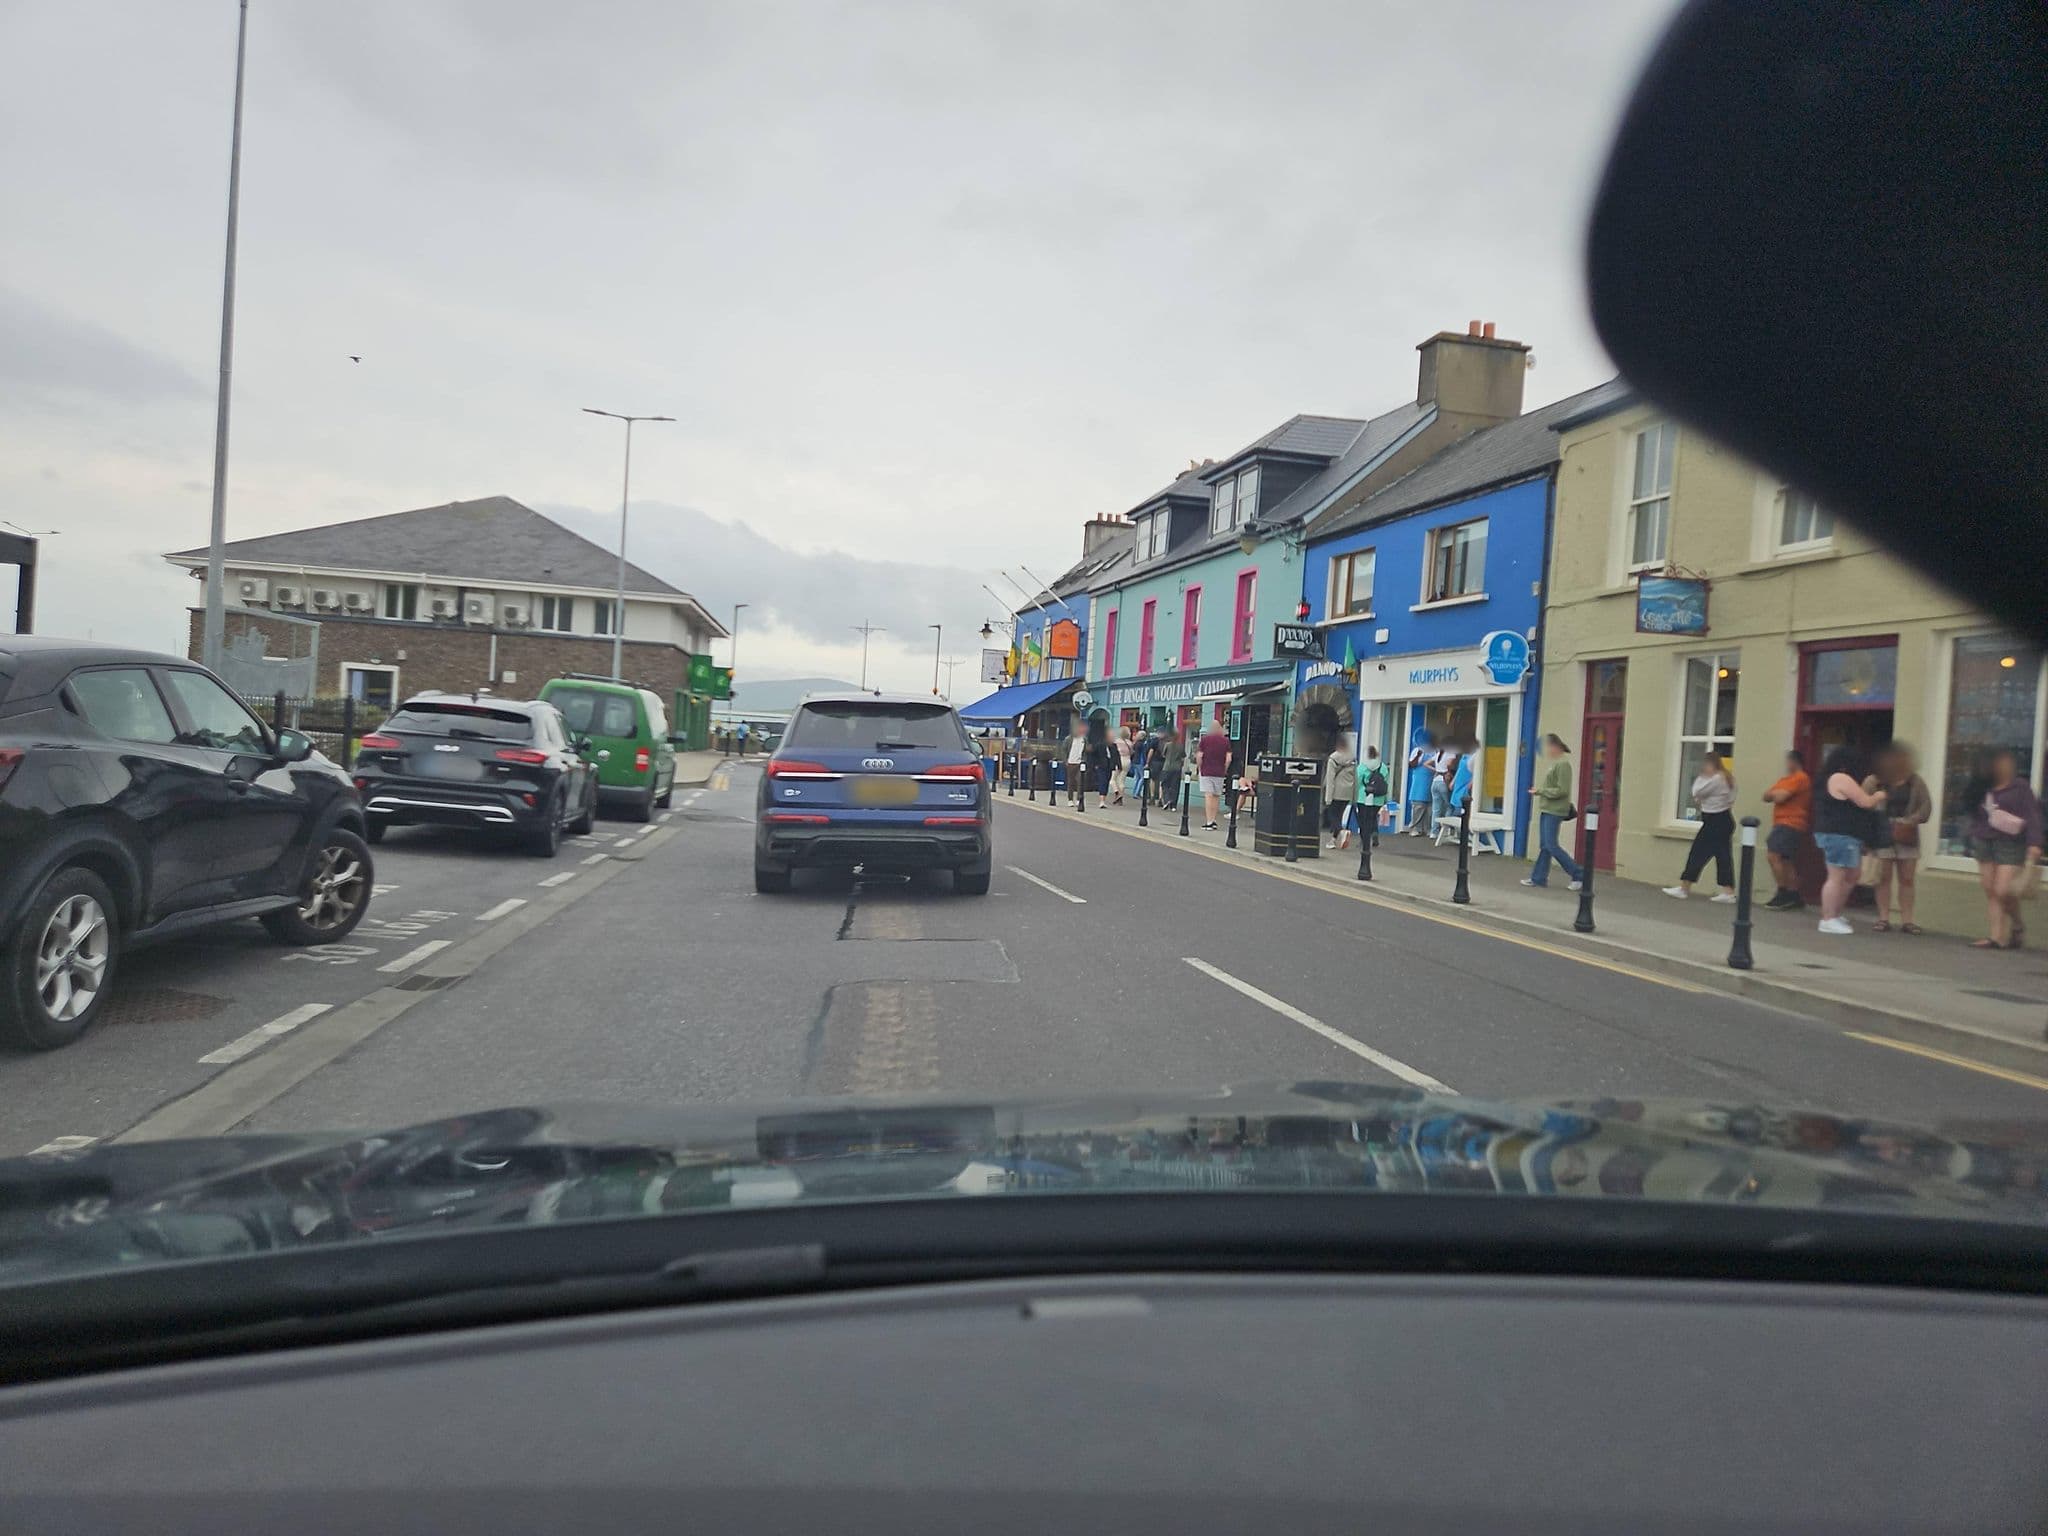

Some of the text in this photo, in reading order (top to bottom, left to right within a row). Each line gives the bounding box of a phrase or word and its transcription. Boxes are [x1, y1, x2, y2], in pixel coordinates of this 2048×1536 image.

[1409, 667, 1459, 684] MURPHYS
[1110, 689, 1123, 704] THE
[1123, 687, 1149, 704] DINGLE
[1154, 683, 1194, 701] WOOLLEN
